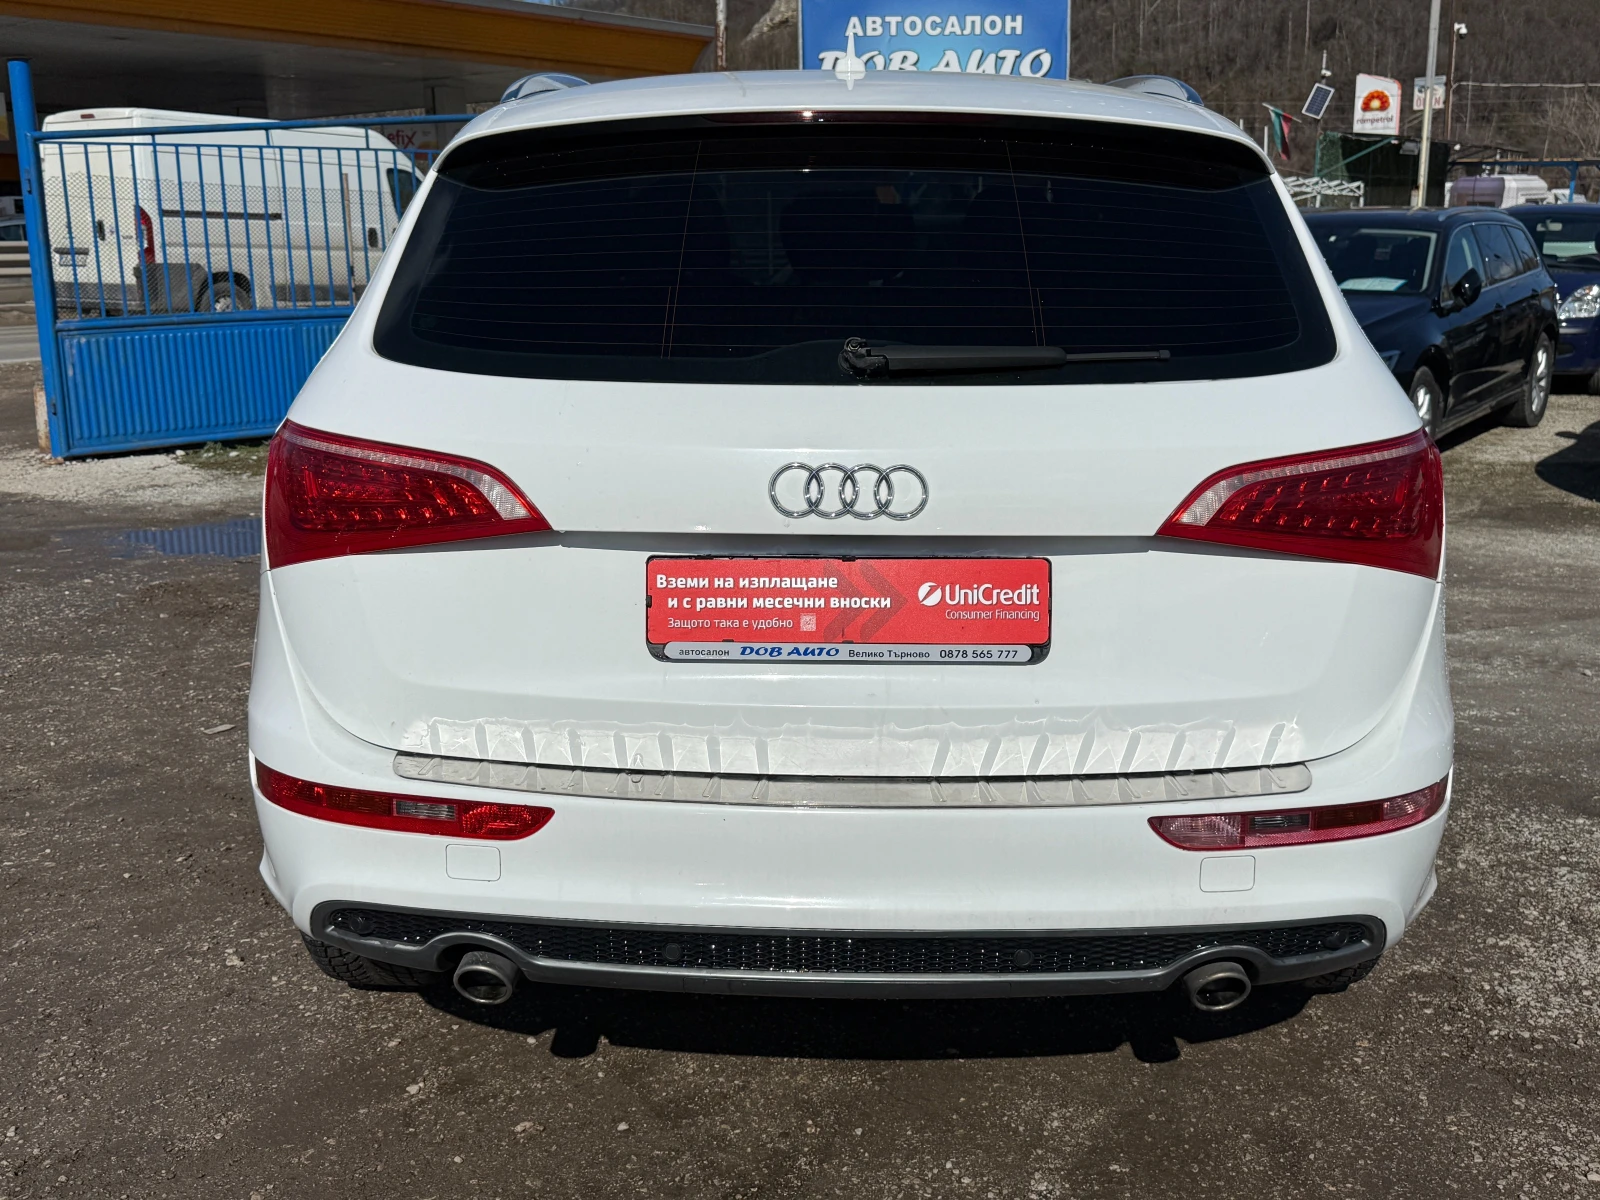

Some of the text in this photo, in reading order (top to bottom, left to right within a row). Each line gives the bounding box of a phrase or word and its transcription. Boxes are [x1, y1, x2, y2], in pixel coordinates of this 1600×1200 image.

[845, 15, 1023, 36] АВТОСАЛОН
[1415, 96, 1441, 108] ON
[1356, 115, 1394, 126] rompetrol
[656, 574, 838, 590] Вземи на изплащане
[945, 583, 1040, 605] UniCredit
[667, 597, 891, 611] и с равни месечни вноски
[945, 609, 1040, 622] Consumer Financing
[667, 617, 793, 630] Защото така е удобно
[678, 648, 730, 656] автосалон
[740, 646, 783, 657] DOB
[848, 649, 1018, 660] Велико Търново 0878 565 777
